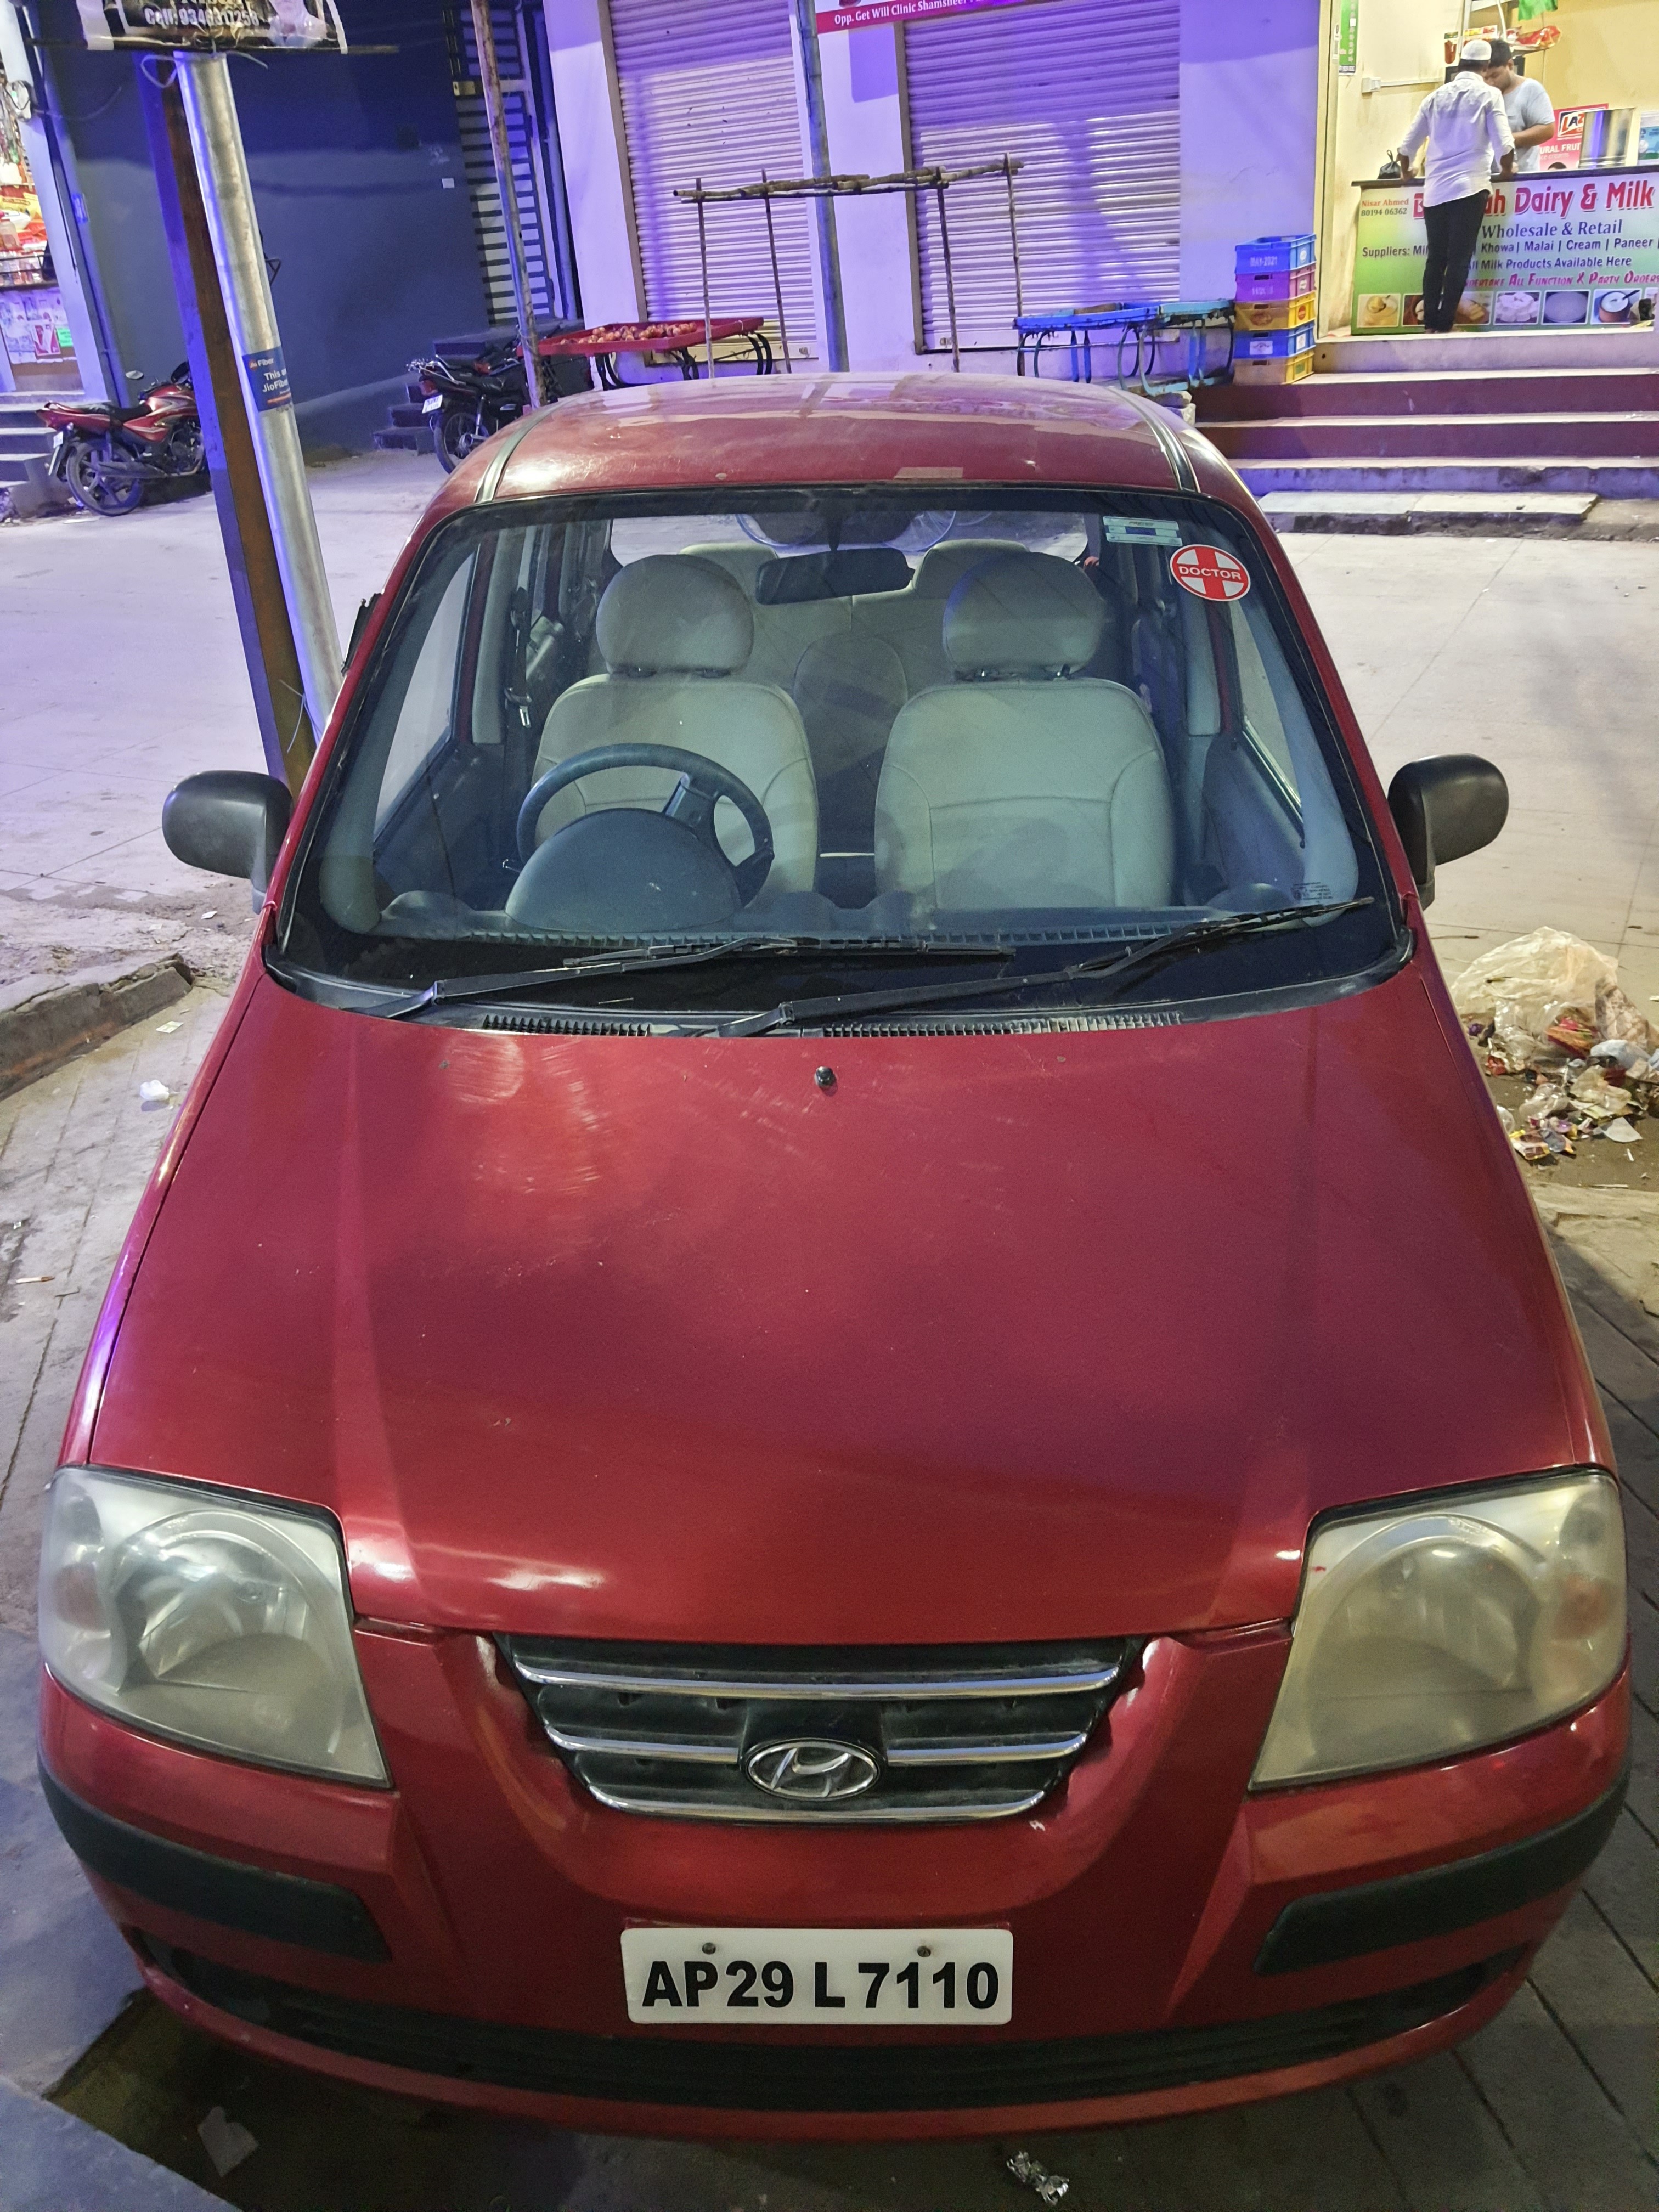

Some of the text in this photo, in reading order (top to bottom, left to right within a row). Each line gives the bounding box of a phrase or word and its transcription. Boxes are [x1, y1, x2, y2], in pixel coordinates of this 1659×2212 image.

[834, 14, 854, 26] Opp.
[856, 10, 870, 21] Get
[872, 6, 889, 19] Will
[891, 1, 916, 15] Clinic
[1561, 114, 1585, 132] LAZ
[1540, 143, 1581, 154] URAL FRUI
[1383, 198, 1409, 206] Ahmed
[1514, 186, 1574, 219] Dairy
[1580, 183, 1598, 212] &
[1606, 180, 1655, 210] Milk
[1482, 219, 1623, 238] Wholesale & Retail
[1362, 245, 1429, 258] Suppliers: Mil
[1524, 240, 1554, 252] Malai
[1566, 239, 1601, 250] Cream
[1614, 238, 1654, 248] Paneer
[1482, 257, 1502, 269] Milk
[1506, 258, 1551, 269] Products
[1554, 256, 1602, 268] Available
[1606, 256, 1632, 267] Here
[264, 370, 281, 381] This
[262, 379, 288, 392] JioFibe
[1179, 566, 1241, 580] DOCTOR
[642, 1961, 999, 2010] AP29 L 7110
